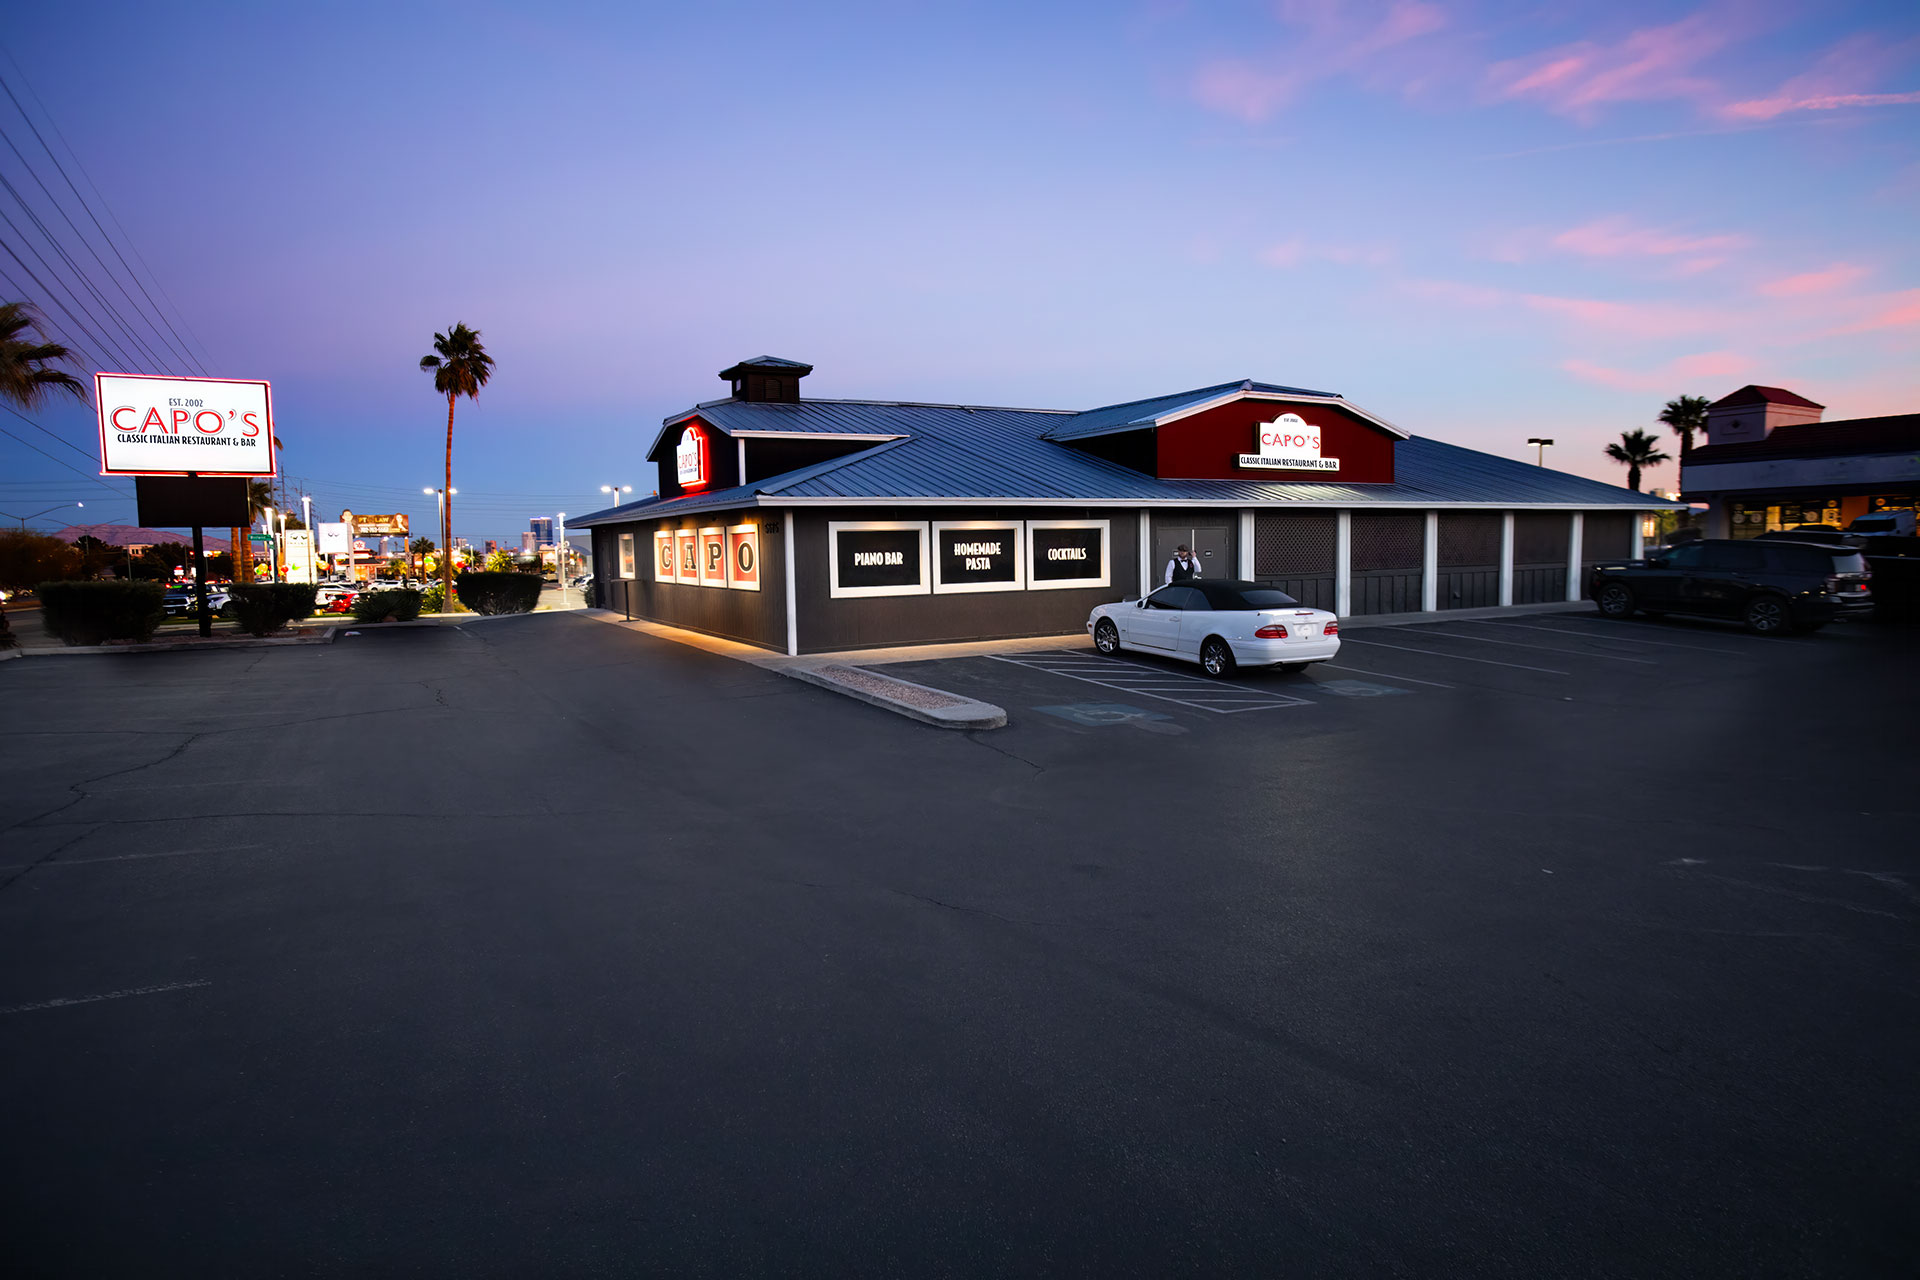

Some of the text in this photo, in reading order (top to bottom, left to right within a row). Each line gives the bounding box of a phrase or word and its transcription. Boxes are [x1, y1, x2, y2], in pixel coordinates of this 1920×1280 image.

[169, 398, 204, 407] EST. 2002
[110, 405, 260, 437] CAPO'S
[117, 433, 256, 447] CLASSIC ITALIAN RESTAURANT & BAR
[1261, 433, 1320, 449] CAPO'S
[1240, 456, 1338, 469] CLASSIC ITALIAN RESTAURANT & BAR
[954, 542, 1001, 556] HOMEMADE
[1047, 547, 1087, 561] COCKTAILS
[660, 541, 755, 573] CAPO
[854, 551, 904, 566] PIANO BAR
[965, 557, 991, 570] PASTA
